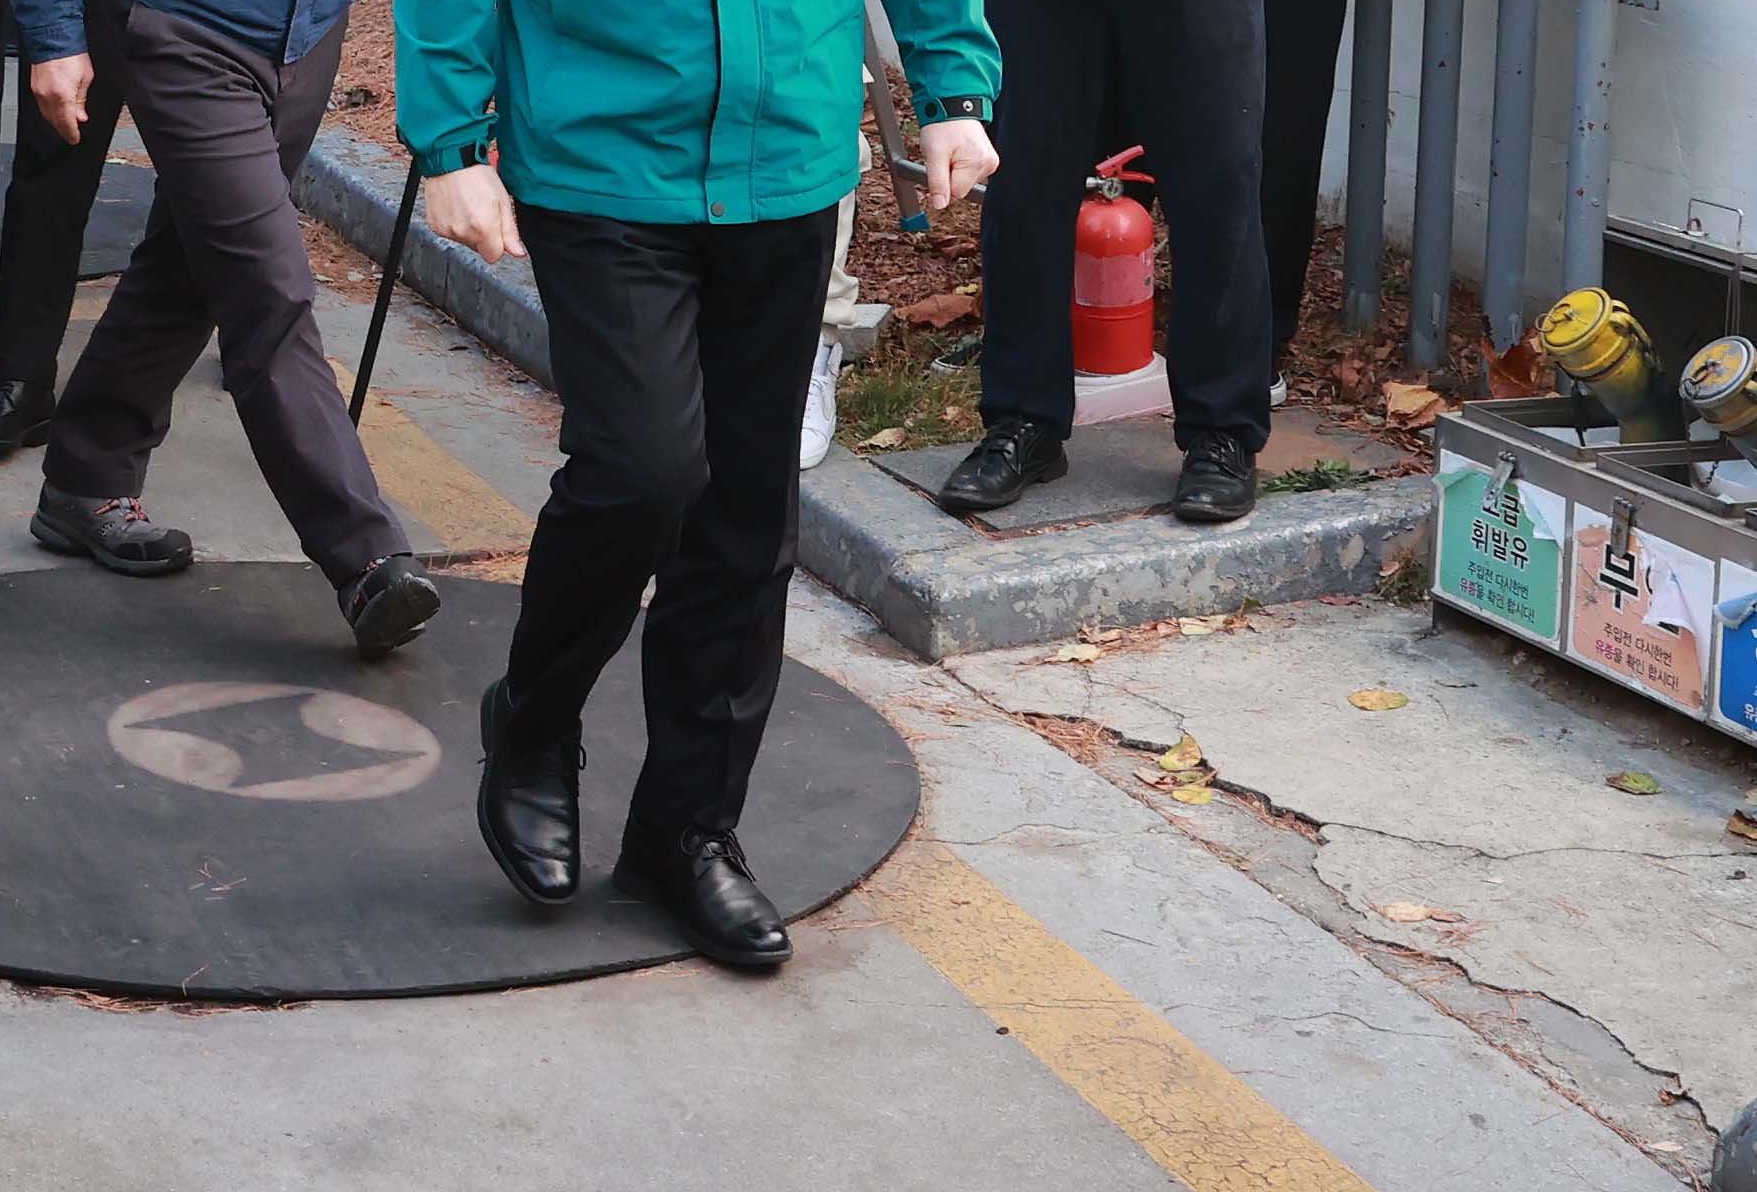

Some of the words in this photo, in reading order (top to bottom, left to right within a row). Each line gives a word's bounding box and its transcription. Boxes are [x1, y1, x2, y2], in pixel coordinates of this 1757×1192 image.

[1470, 519, 1529, 570] 휘발유
[1467, 561, 1493, 585] 주입전
[1495, 573, 1530, 601] 다시한번
[1603, 622, 1633, 648] 주입전
[1635, 637, 1673, 669] 다시한번
[1647, 663, 1679, 694] 합시다!
